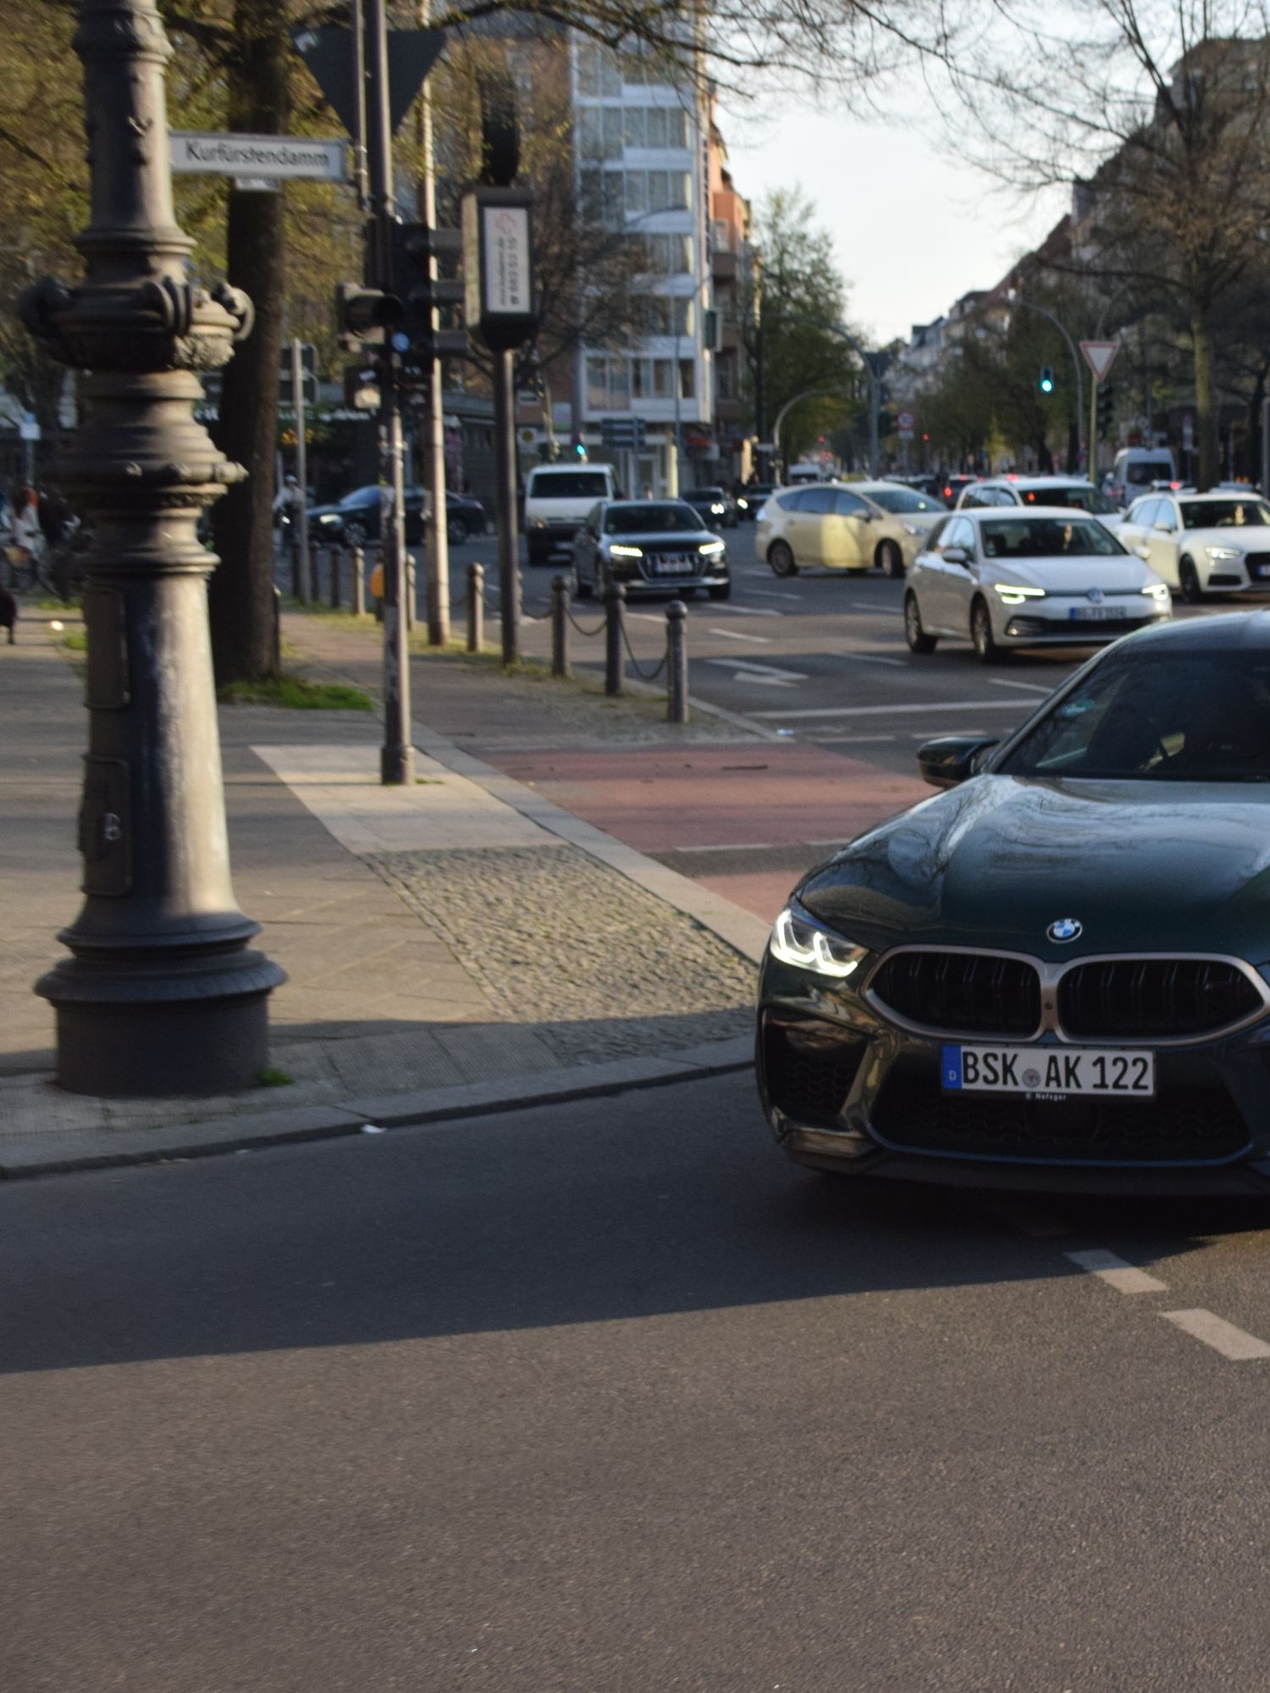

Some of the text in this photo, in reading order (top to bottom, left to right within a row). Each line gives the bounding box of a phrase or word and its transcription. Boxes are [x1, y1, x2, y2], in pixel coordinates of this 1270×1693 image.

[186, 140, 329, 166] Kurfürstendamm
[961, 1051, 1149, 1091] BSK AK 122
